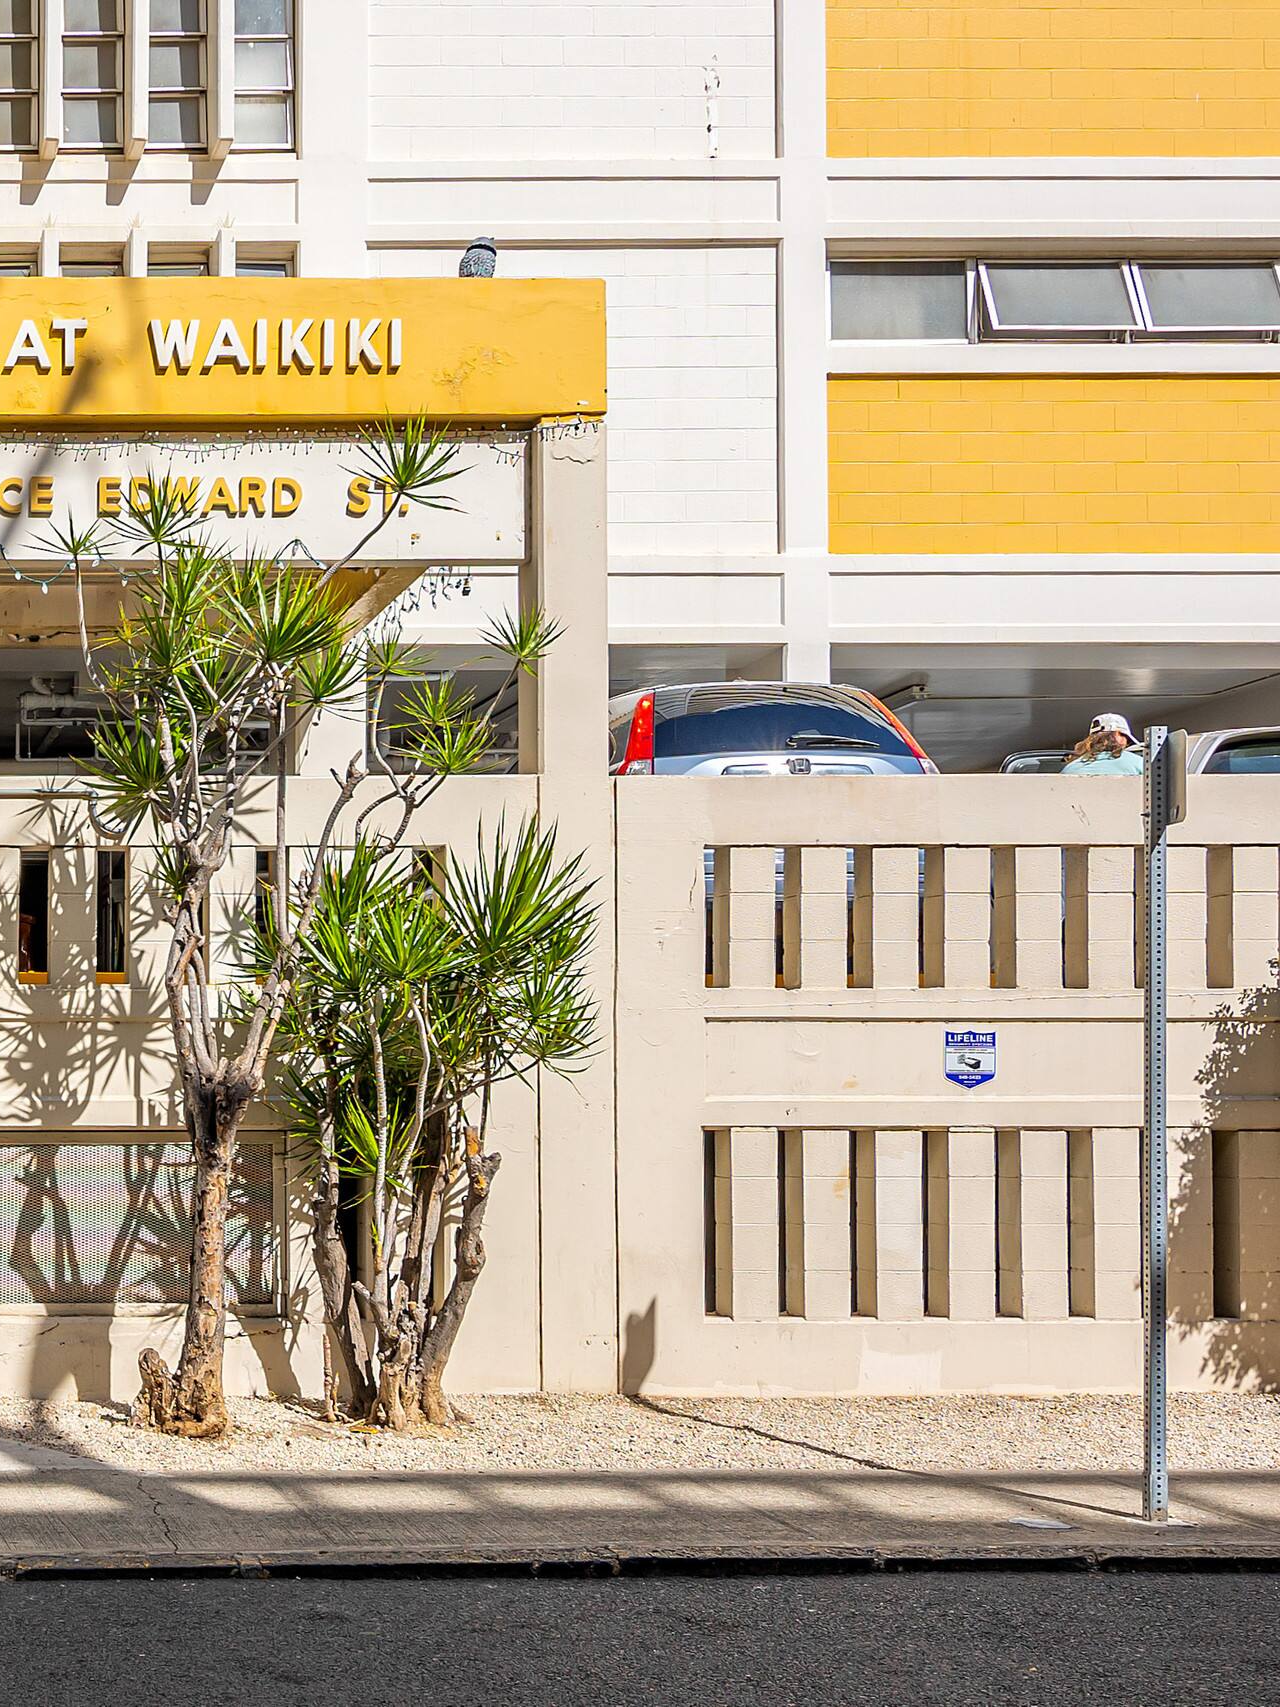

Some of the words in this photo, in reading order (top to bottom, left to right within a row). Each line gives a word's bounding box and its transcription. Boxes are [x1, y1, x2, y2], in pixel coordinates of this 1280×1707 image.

[3, 318, 88, 375] AT
[148, 317, 403, 375] WAIKIKI
[96, 475, 304, 518] EDWARD
[948, 1034, 993, 1042] LIFELINE
